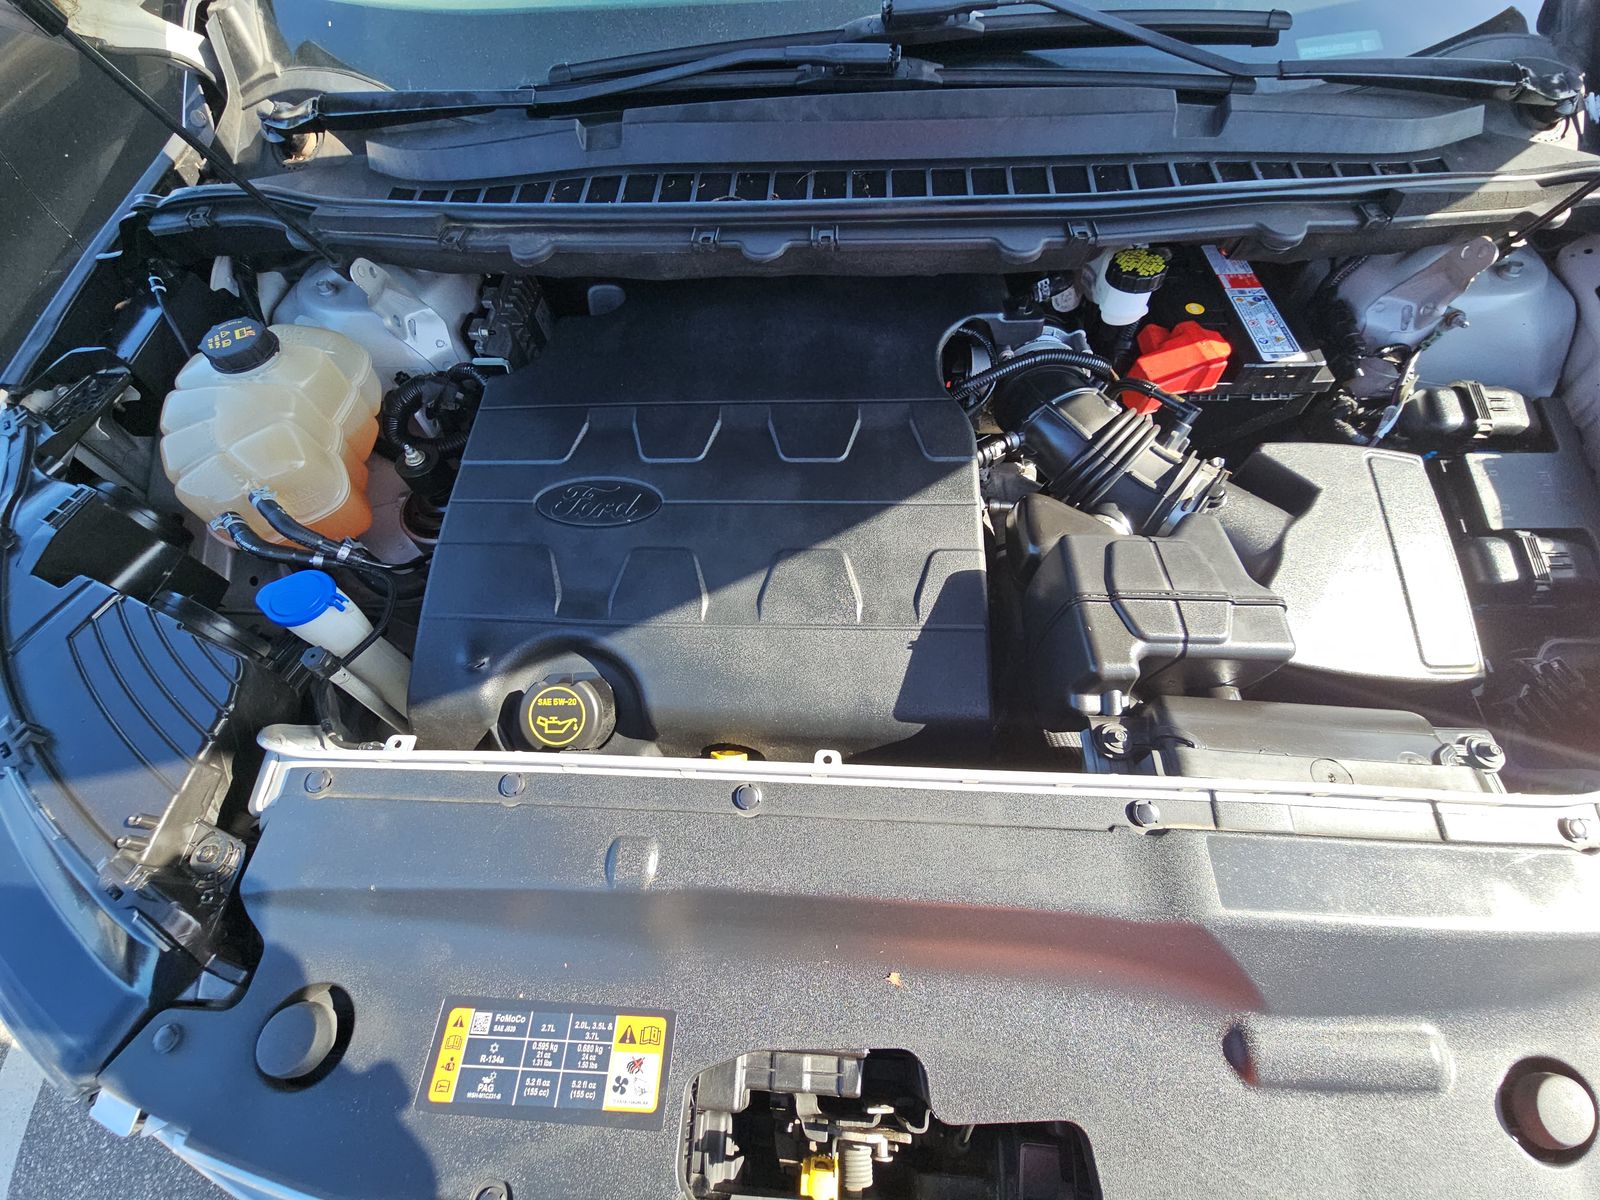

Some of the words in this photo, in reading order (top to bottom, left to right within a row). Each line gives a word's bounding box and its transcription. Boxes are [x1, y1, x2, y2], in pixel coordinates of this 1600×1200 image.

[551, 485, 641, 518] Ford
[537, 698, 552, 706] SAE
[553, 698, 577, 706] 5W-20
[495, 1013, 526, 1023] FoMoCo
[540, 1024, 555, 1032] 2.7L
[574, 1021, 590, 1031] 2.0L,
[592, 1022, 606, 1030] 3.5L
[607, 1023, 613, 1031] &
[585, 1032, 599, 1040] 3.7L
[532, 1042, 549, 1050] 0.595
[550, 1043, 558, 1052] kg
[577, 1044, 594, 1052] 0.680
[595, 1045, 603, 1054] kg
[480, 1055, 504, 1063] R-134a
[526, 1078, 535, 1086] 5.2
[536, 1078, 541, 1086] fl
[477, 1083, 494, 1092] PAG
[524, 1087, 538, 1096] (155
[539, 1089, 549, 1098] cc)
[570, 1090, 584, 1099] (155
[585, 1091, 595, 1101] cc)
